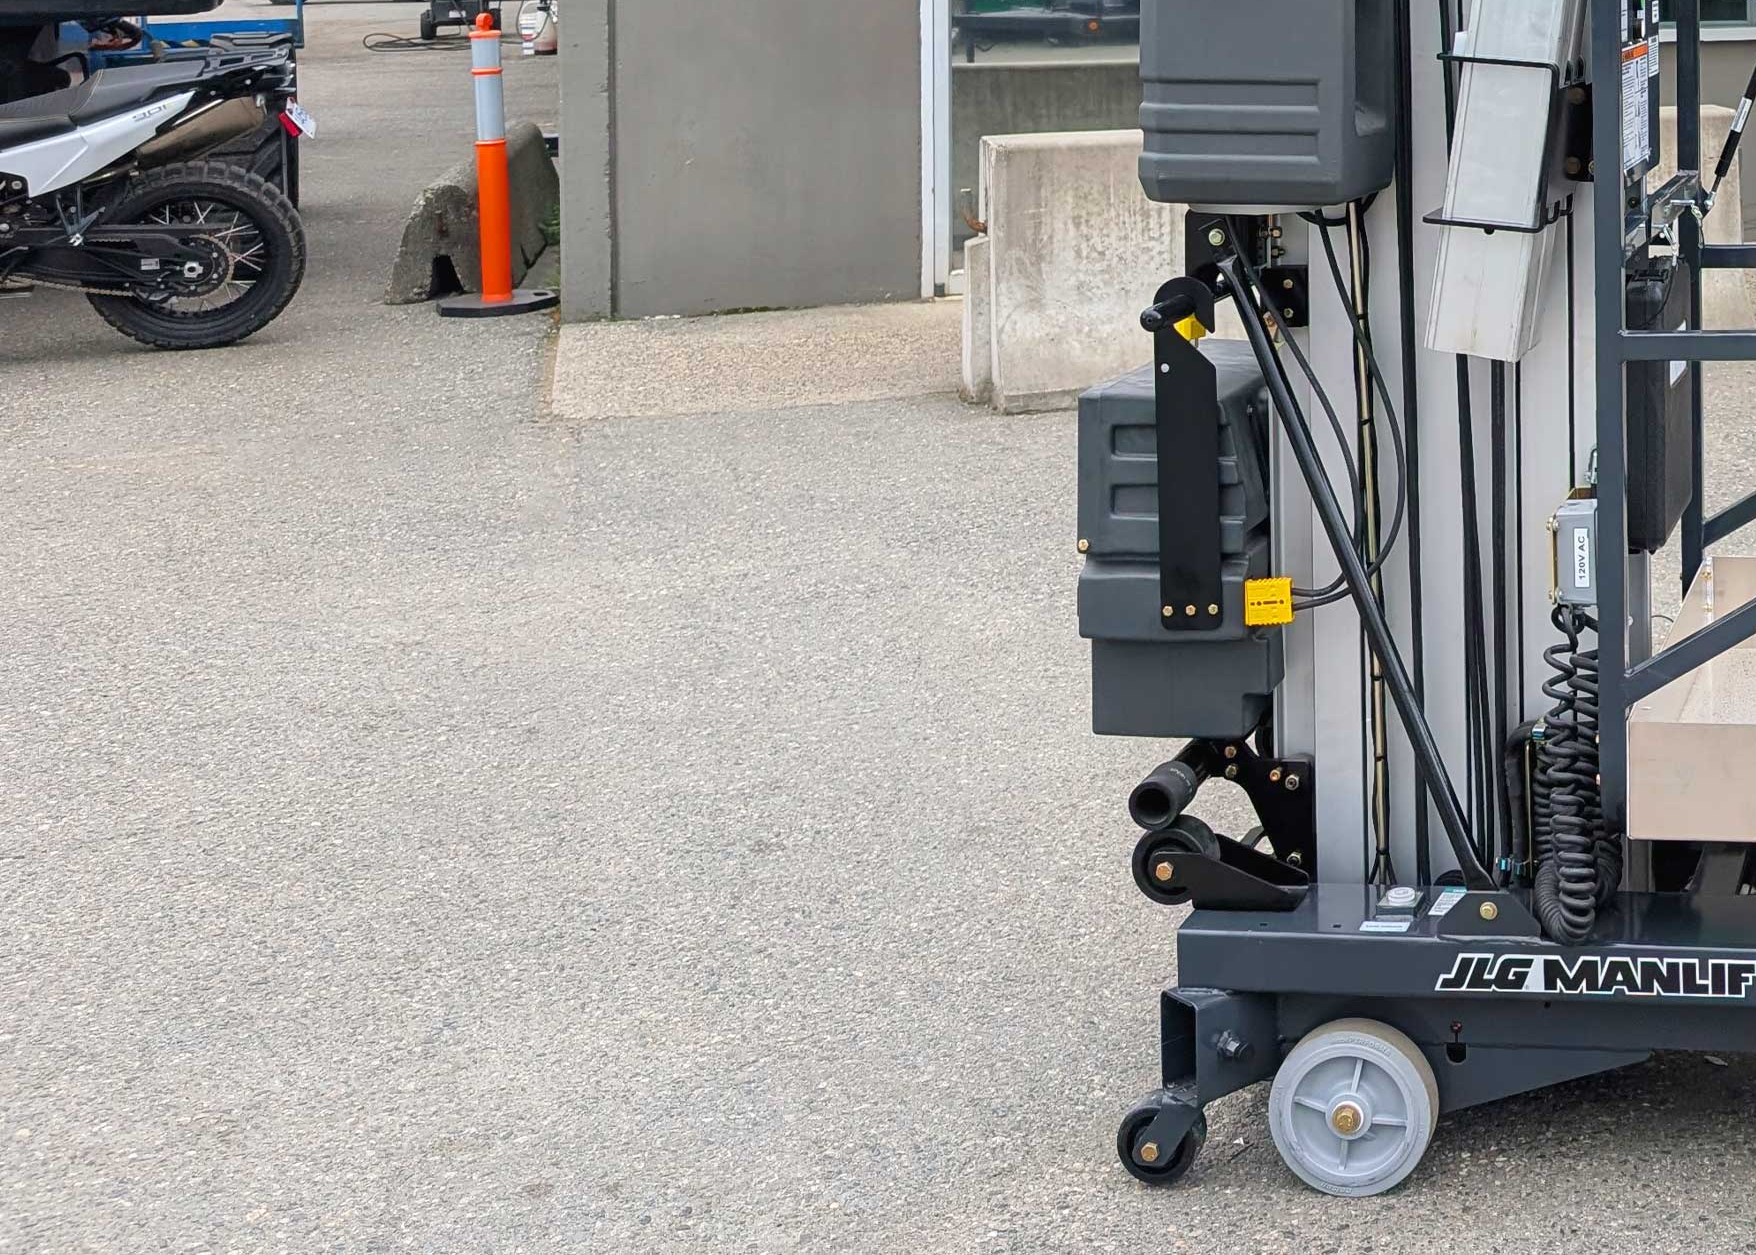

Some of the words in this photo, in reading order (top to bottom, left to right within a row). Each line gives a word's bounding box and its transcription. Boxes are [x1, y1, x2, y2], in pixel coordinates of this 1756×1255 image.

[1577, 535, 1586, 552] AC
[1578, 554, 1586, 580] 120V
[1436, 954, 1535, 991] JLG
